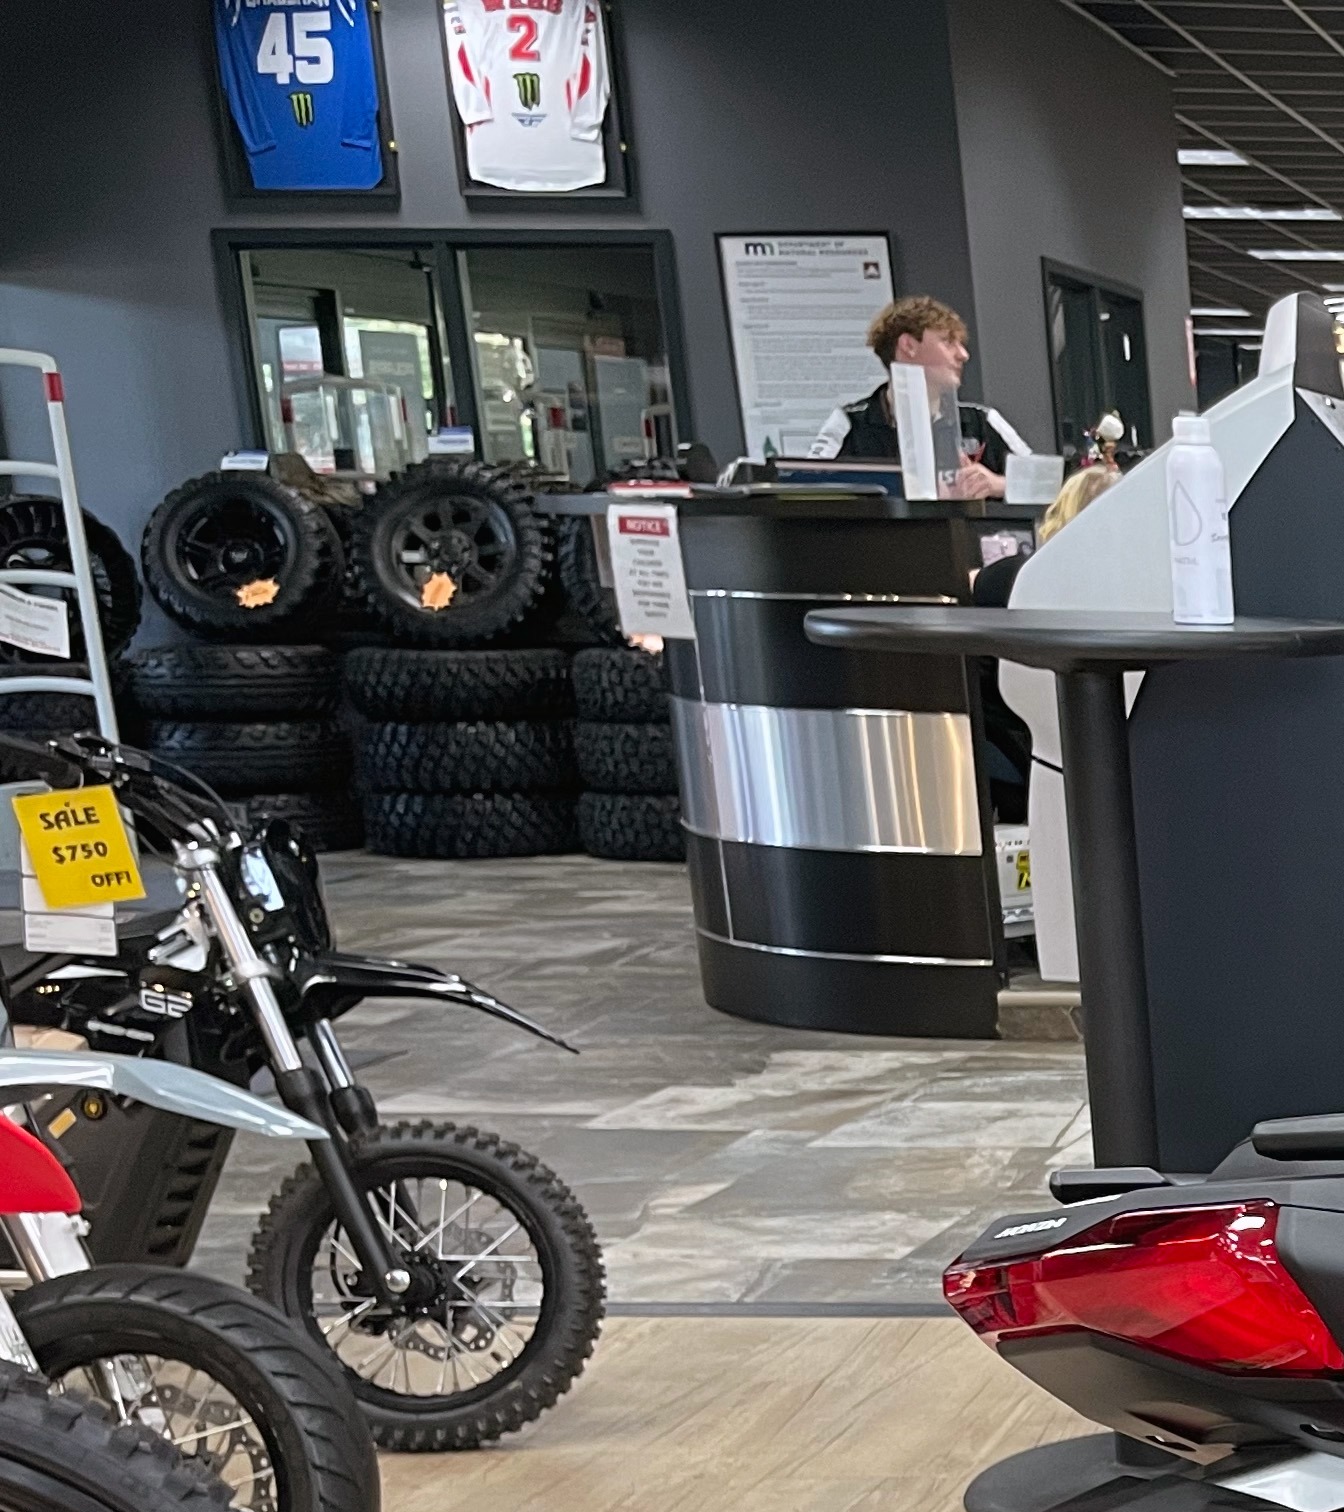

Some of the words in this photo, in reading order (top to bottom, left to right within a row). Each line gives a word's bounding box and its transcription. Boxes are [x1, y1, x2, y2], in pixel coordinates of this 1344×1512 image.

[257, 11, 334, 84] 45
[507, 14, 541, 62] 2
[39, 806, 101, 830] SALE
[52, 841, 108, 865] $750
